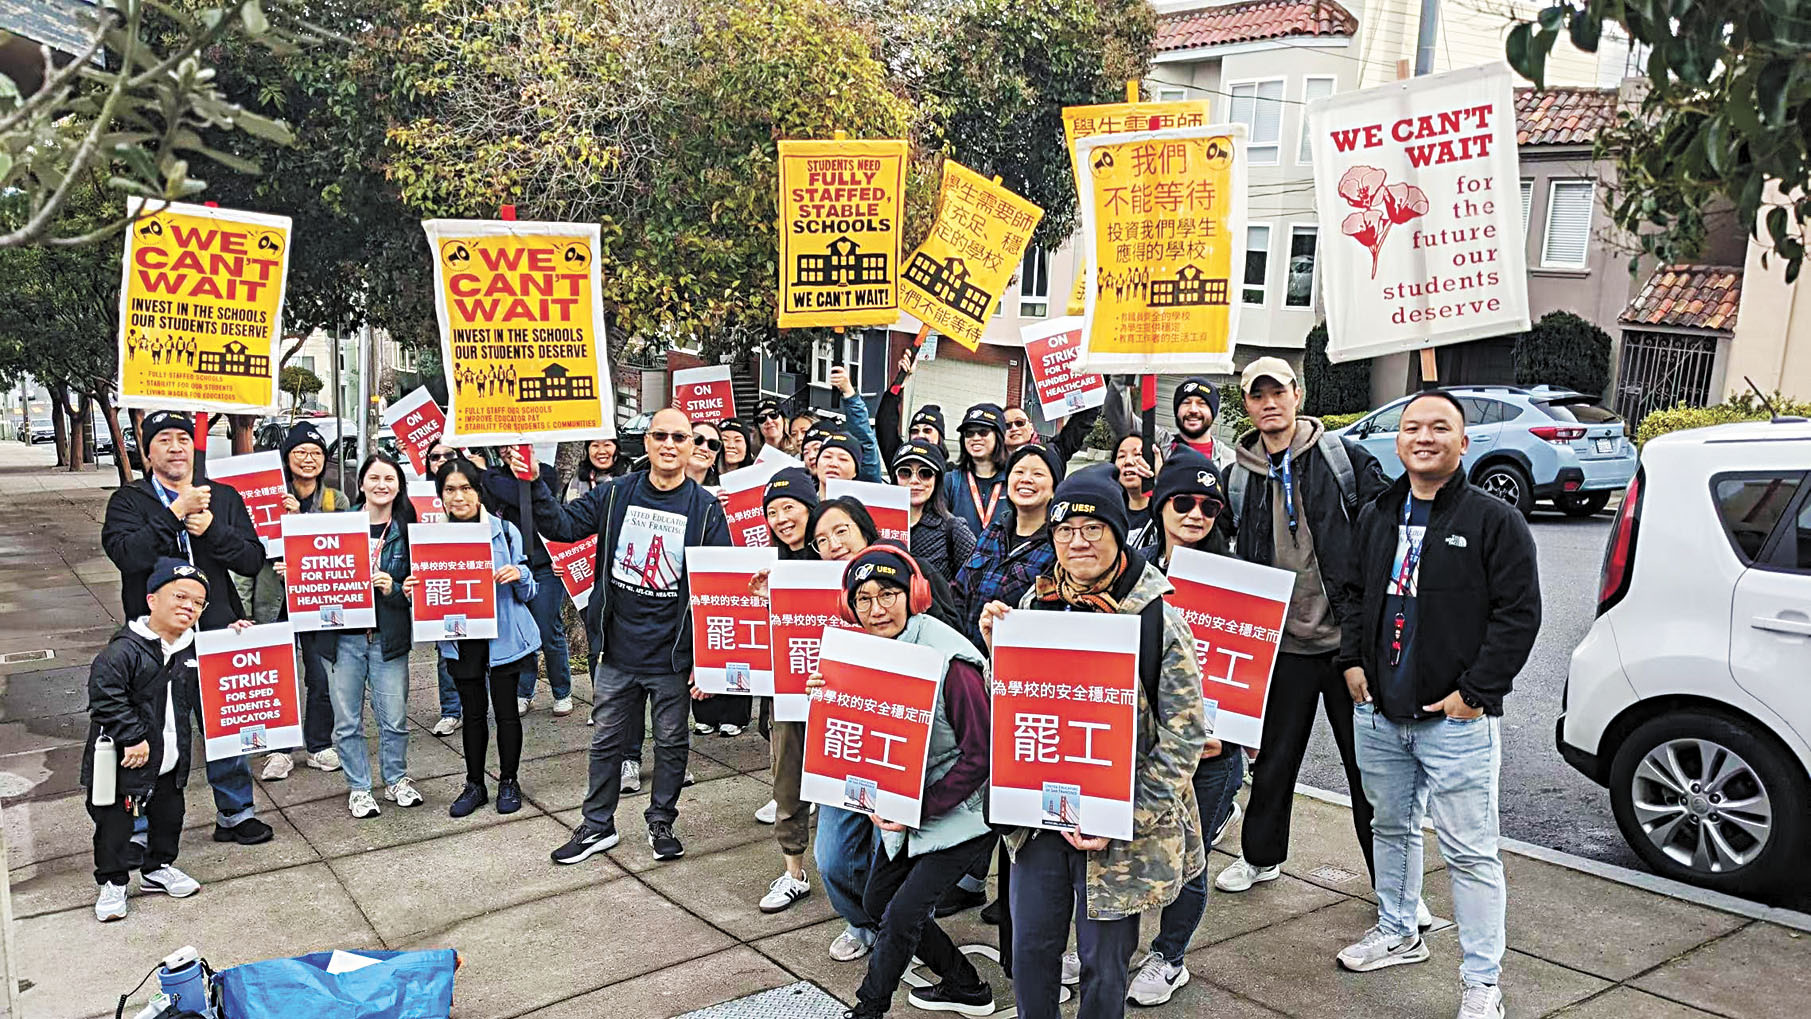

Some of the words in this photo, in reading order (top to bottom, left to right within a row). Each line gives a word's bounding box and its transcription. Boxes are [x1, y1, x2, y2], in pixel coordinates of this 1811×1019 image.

[1330, 124, 1382, 152] WE
[1391, 104, 1493, 143] CAN'T
[1405, 133, 1492, 168] WAIT
[807, 160, 854, 172] STUDENTS
[858, 160, 880, 171] NEED
[1131, 143, 1187, 177] 我們
[809, 172, 876, 186] FULLY
[1457, 176, 1493, 194] for
[792, 188, 891, 203] STAFFED,
[1103, 180, 1216, 216] 不能等待
[799, 204, 879, 218] STABLE
[1453, 199, 1494, 219] the
[793, 219, 891, 234] SCHOOLS
[1107, 217, 1216, 242] 投資我們學生
[170, 225, 248, 255] WE
[1412, 224, 1496, 249] future
[936, 220, 1004, 273] 定的學校
[1116, 240, 1206, 264] 應得的學校
[479, 248, 556, 272] WE
[1452, 248, 1498, 267] our
[137, 270, 266, 302] WAIT
[1384, 270, 1499, 300] students
[794, 292, 813, 308] WE
[816, 290, 852, 307] CAN'T
[855, 289, 889, 305] WAIT!
[132, 298, 173, 314] INVEST
[176, 300, 188, 316] IN
[193, 304, 214, 319] THE
[217, 307, 266, 324] SCHOOLS
[454, 298, 579, 323] WAIT
[1392, 298, 1500, 324] deserve
[131, 313, 155, 328] OUR
[159, 316, 217, 335] STUDENTS
[221, 323, 268, 338] DESERVE
[453, 329, 490, 344] INVEST
[494, 328, 504, 343] IN
[508, 328, 528, 343] THE
[532, 328, 583, 343] SCHOOLS
[1048, 334, 1068, 348] ON
[455, 345, 477, 360] OUR
[481, 344, 534, 360] STUDENTS
[539, 344, 587, 358] DESERVE
[1044, 366, 1061, 376] FOR
[694, 385, 712, 395] ON
[1038, 374, 1069, 389] FUNDED
[1046, 376, 1096, 397] HEALTHCARE
[687, 398, 723, 411] STRIKE
[407, 411, 423, 427] ON
[514, 422, 545, 430] STUDENTS
[553, 420, 596, 428] COMMUNITIES
[407, 419, 440, 444] STRIKE
[417, 439, 429, 449] FOR
[432, 498, 442, 508] O
[1072, 504, 1095, 513] UESF
[630, 510, 650, 520] NITED
[313, 536, 340, 550] ON
[301, 555, 355, 570] STRIKE
[411, 559, 493, 571] 為學校的安全穩定而
[567, 553, 596, 583] 罷
[877, 565, 896, 576] UESF
[301, 569, 322, 581] FOR
[325, 568, 356, 579] FULLY
[289, 582, 330, 594] FUNDED
[332, 580, 370, 592] FAMILY
[425, 578, 484, 607] 罷工
[297, 592, 364, 606] HEALTHCARE
[690, 594, 769, 608] 為學校的安全穩定
[706, 616, 768, 650] 罷工
[232, 651, 261, 668] ON
[219, 670, 279, 691] STRIKE
[225, 691, 246, 702] FOR
[248, 688, 274, 699] SPED
[993, 680, 1135, 706] 為學校的安全穩定而
[220, 700, 270, 715] STUDENTS
[272, 698, 281, 706] &
[810, 686, 932, 726] 為學校的安全穩定而
[220, 710, 280, 727] EDUCATORS
[824, 718, 908, 772] 罷工
[1014, 712, 1112, 766] 罷工
